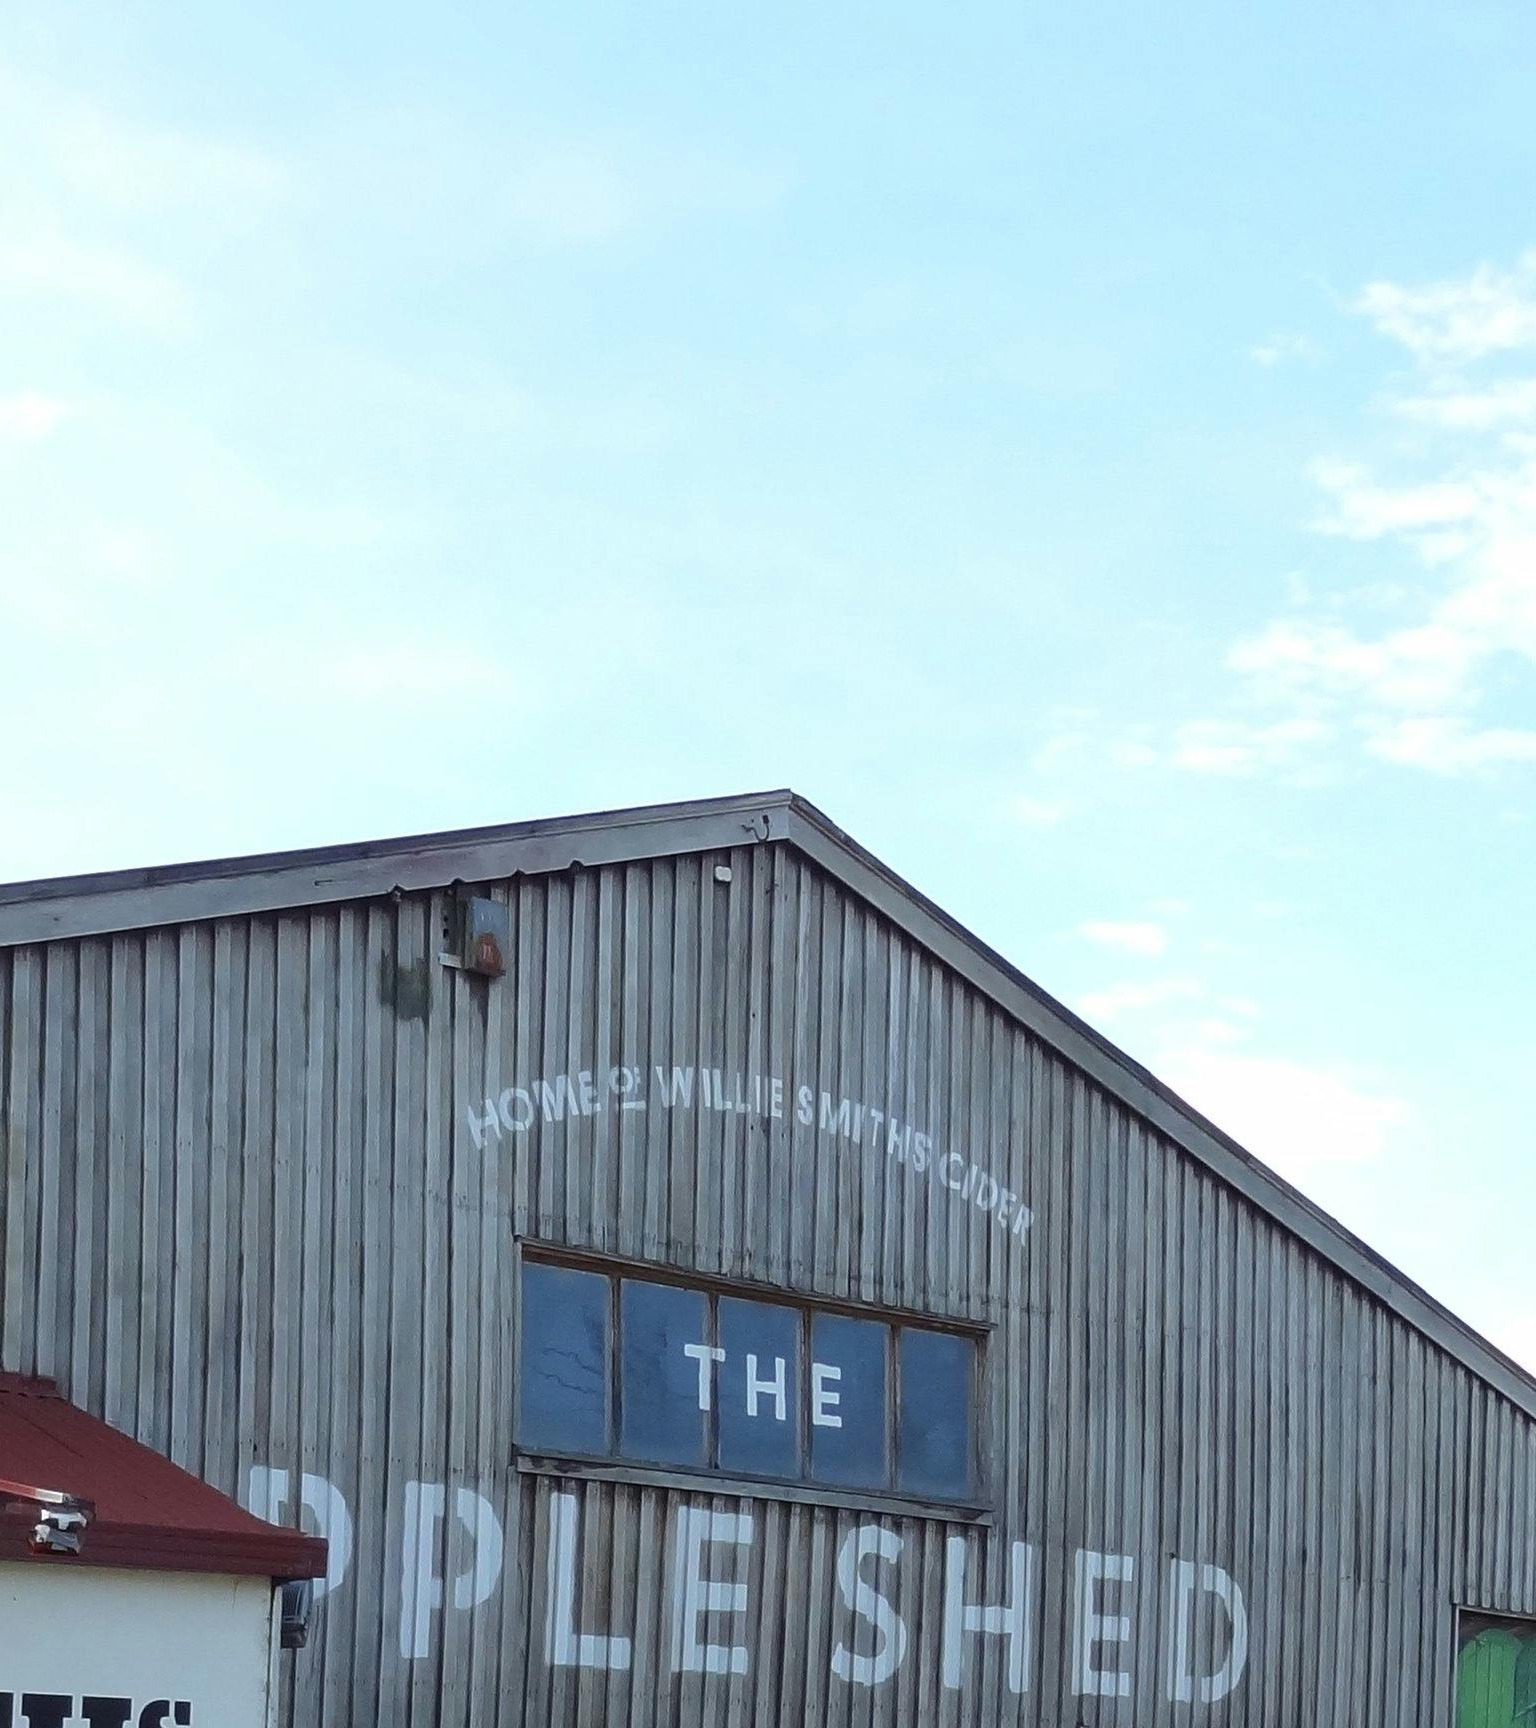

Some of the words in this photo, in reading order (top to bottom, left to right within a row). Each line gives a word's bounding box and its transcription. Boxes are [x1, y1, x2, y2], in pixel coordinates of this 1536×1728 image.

[467, 1070, 602, 1150] HOME
[655, 1065, 783, 1118] WILLIE
[797, 1084, 932, 1173] SMITHS
[938, 1151, 1035, 1247] CIDER
[684, 1343, 843, 1428] THE
[249, 1464, 754, 1676] PPLE
[830, 1522, 1248, 1704] SHED
